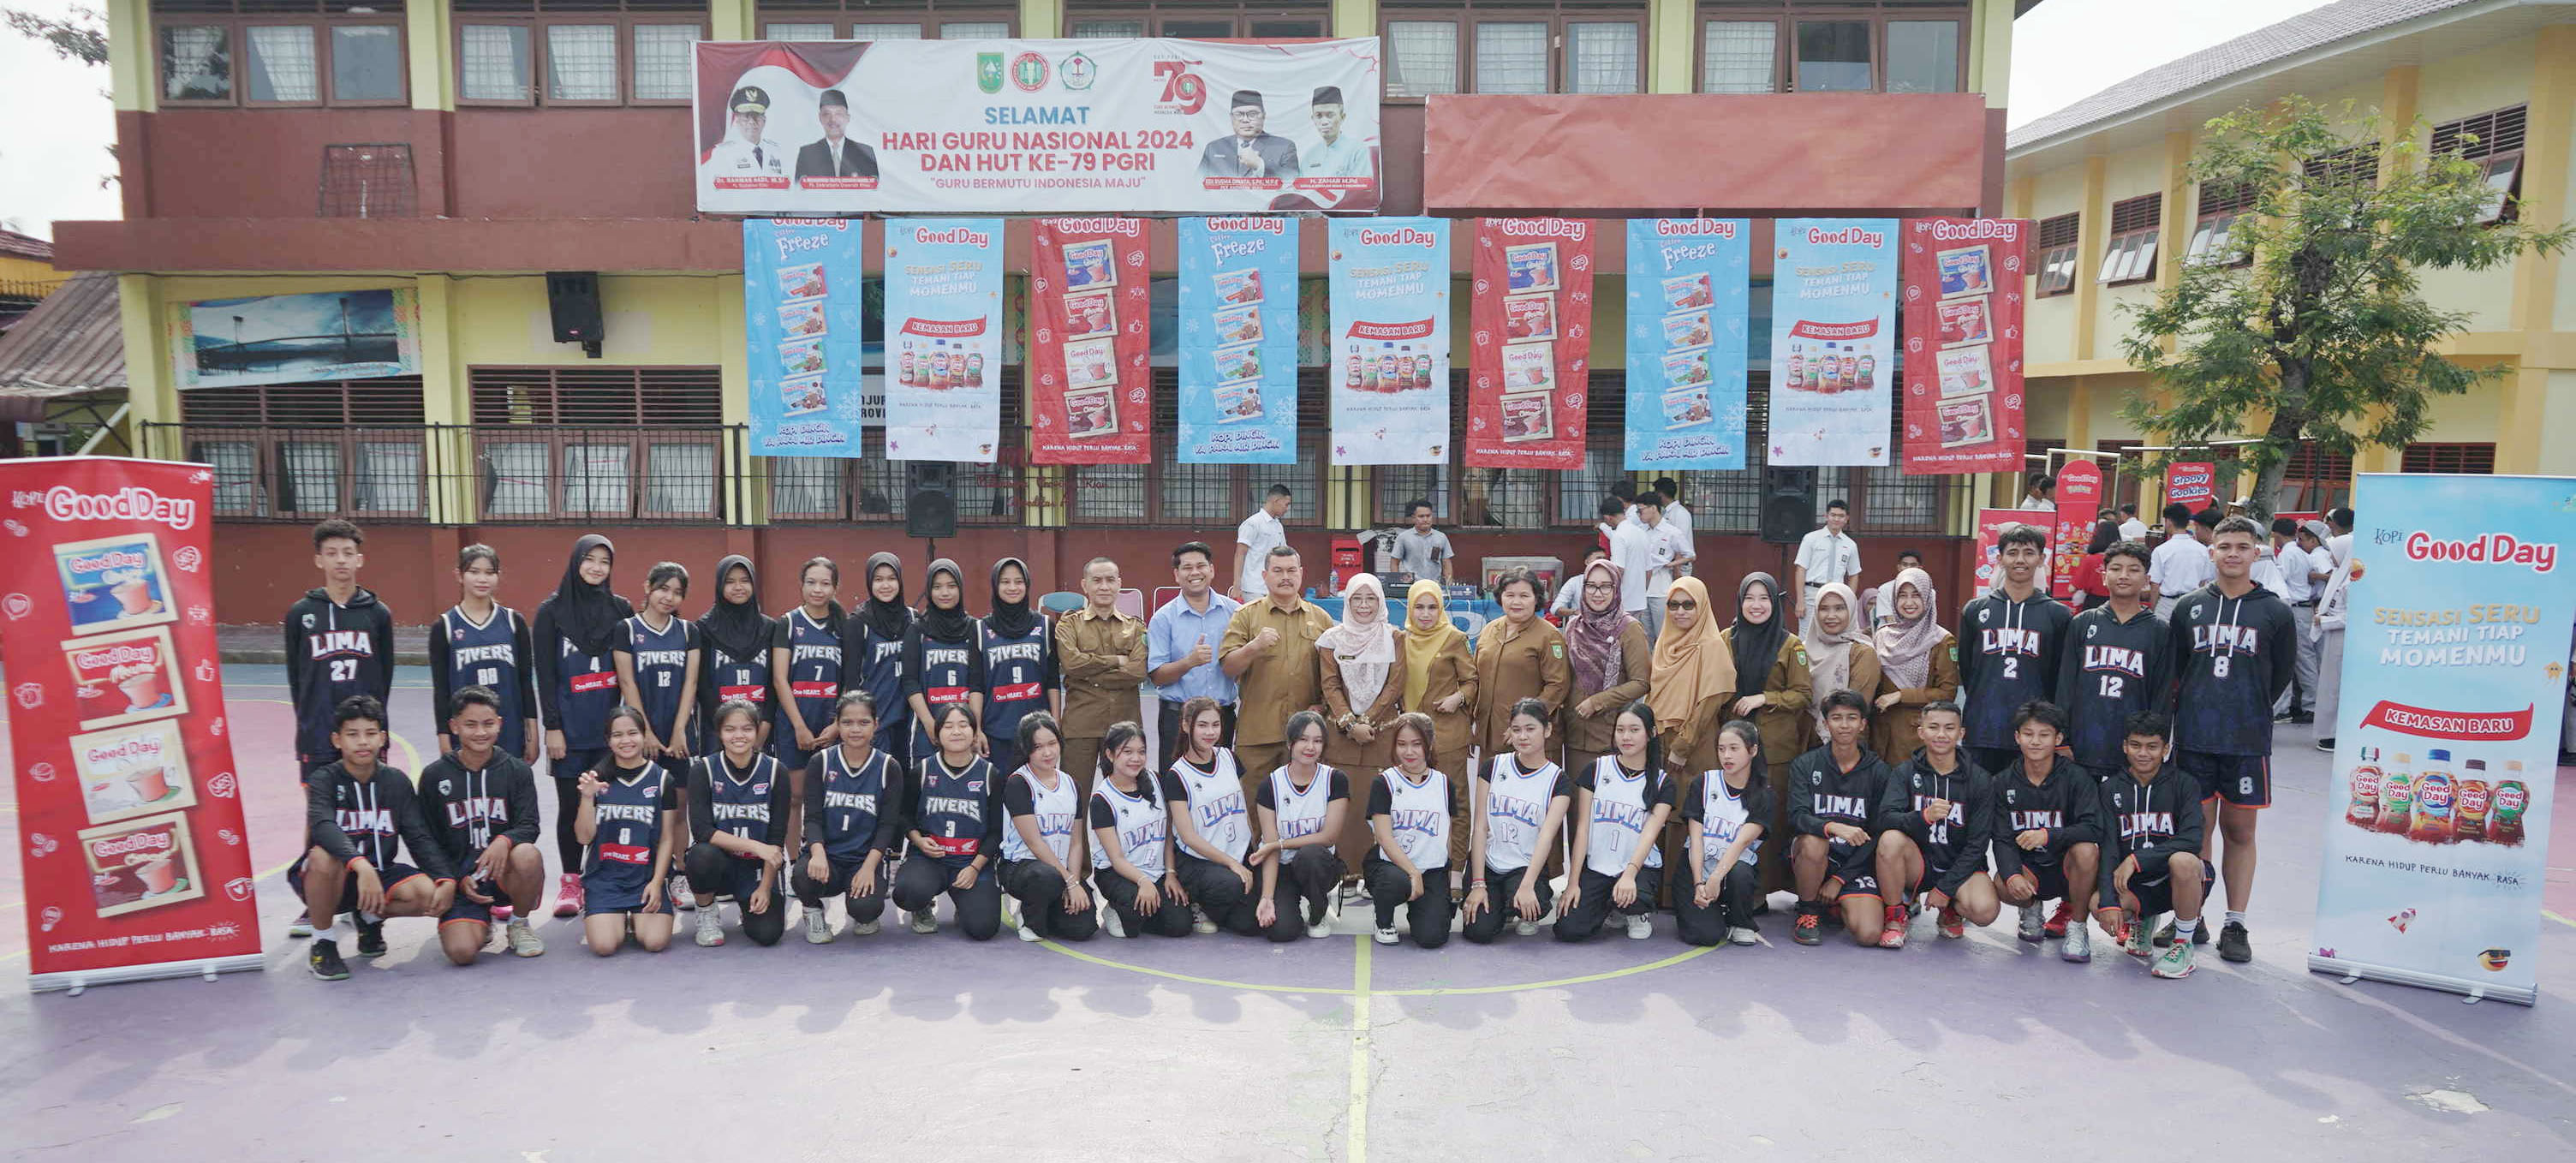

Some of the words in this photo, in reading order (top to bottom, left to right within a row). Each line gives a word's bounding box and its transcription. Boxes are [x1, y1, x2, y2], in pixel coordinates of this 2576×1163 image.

[985, 105, 1090, 126] SELAMAT
[882, 131, 937, 152] HARI
[942, 131, 1006, 151] GURU
[1013, 130, 1131, 151] NASIONAL
[1136, 130, 1194, 150] 2024
[921, 152, 969, 172] DAN
[977, 152, 1020, 171] HUT
[1029, 152, 1096, 172] KE-79
[1102, 152, 1155, 171] PGRI
[930, 177, 970, 189] "GURU
[974, 177, 1032, 188] BERMUTU
[1035, 177, 1101, 188] INDONESIA
[1105, 176, 1147, 188] MAJU"
[916, 227, 956, 244] Good
[958, 227, 989, 248] Day
[1058, 218, 1104, 234] Good
[1104, 218, 1139, 237] Day
[1207, 217, 1250, 232] Good
[1251, 217, 1285, 236] Day
[1502, 218, 1548, 236] Good
[1548, 218, 1585, 242] Day
[1657, 218, 1698, 235] Good
[1702, 219, 1735, 238] Day
[1808, 227, 1848, 244] Good
[1852, 227, 1883, 248] Day
[1932, 218, 1980, 240] Good
[1980, 218, 2017, 242] Day
[774, 232, 829, 261] Freeze
[1361, 228, 1400, 246] Good
[1404, 228, 1434, 248] Day
[1211, 237, 1266, 267] Freeze
[1661, 241, 1715, 271] Freeze
[1355, 283, 1425, 300] MOMENMU
[1800, 283, 1870, 299] MOMENMU
[911, 320, 953, 333] KEMASAN
[953, 322, 979, 334] BARU
[1358, 325, 1400, 337] KEMASAN
[1400, 323, 1426, 336] BARU
[1802, 324, 1844, 337] KEMASAN
[1845, 324, 1871, 336] BARU
[2172, 473, 2209, 485] Groovy
[2170, 486, 2210, 498] Cookies
[45, 485, 129, 522] Good
[128, 486, 195, 531] Day
[69, 552, 110, 574] Good
[109, 551, 146, 569] Day
[2406, 531, 2487, 563] Good
[2490, 534, 2557, 573] Day
[2373, 605, 2462, 627] SENSASI
[2468, 603, 2541, 625] SERU
[309, 630, 374, 660] LIMA
[1982, 627, 2041, 657] LIMA
[2192, 623, 2260, 657] LIMA
[2388, 627, 2469, 647] TEMANI
[2477, 624, 2525, 641] TIAP
[76, 647, 120, 670] Good
[119, 646, 154, 663] Day
[456, 644, 516, 672] FIVERS
[589, 656, 601, 673] 4
[637, 650, 686, 673] FIVERS
[791, 644, 842, 667] FIVERS
[987, 643, 1041, 671] FIVERS
[2083, 644, 2144, 677] LIMA
[2379, 644, 2526, 667] MOMENMU
[329, 659, 358, 682] 27
[814, 665, 823, 682] 7
[947, 669, 957, 686] 6
[1012, 666, 1022, 683] 9
[2003, 657, 2018, 678] 2
[2212, 656, 2230, 678] 8
[657, 671, 671, 687] 12
[2099, 674, 2124, 699] 12
[2385, 709, 2465, 733] KEMASAN
[2468, 717, 2513, 734] BARU
[88, 744, 127, 762] Good
[129, 739, 161, 754] Day
[2239, 775, 2254, 795] 8
[2355, 773, 2379, 784] Good
[2357, 782, 2378, 793] Day
[2385, 781, 2411, 792] Good
[2421, 782, 2451, 794] Good
[824, 790, 878, 816] FIVERS
[2388, 790, 2409, 801] Day
[2423, 791, 2449, 805] Day
[2459, 789, 2486, 800] Good
[2461, 797, 2484, 809] Day
[2496, 789, 2523, 800] Good
[2498, 797, 2521, 809] Day
[447, 797, 508, 828] LIMA
[596, 803, 655, 826] FIVERS
[713, 803, 771, 824] FIVERS
[925, 796, 982, 824] FIVERS
[1488, 792, 1539, 827] LIMA
[1593, 797, 1648, 834] LIMA
[1814, 793, 1867, 820] LIMA
[335, 808, 397, 836] LIMA
[842, 814, 850, 832] 1
[945, 820, 956, 838] 3
[1224, 821, 1237, 843] 9
[2010, 810, 2064, 832] LIMA
[2120, 812, 2175, 841] LIMA
[92, 835, 137, 857] Good
[135, 832, 171, 849] Day
[618, 827, 630, 845] 8
[1500, 822, 1520, 846] 12
[1610, 830, 1620, 852] 1
[2345, 855, 2385, 868] KARENA
[2388, 860, 2417, 872] HIDUP
[2420, 863, 2449, 876] PERLU
[2452, 868, 2490, 881] BANYAK
[2496, 874, 2519, 886] RASA
[1854, 875, 1877, 889] 13
